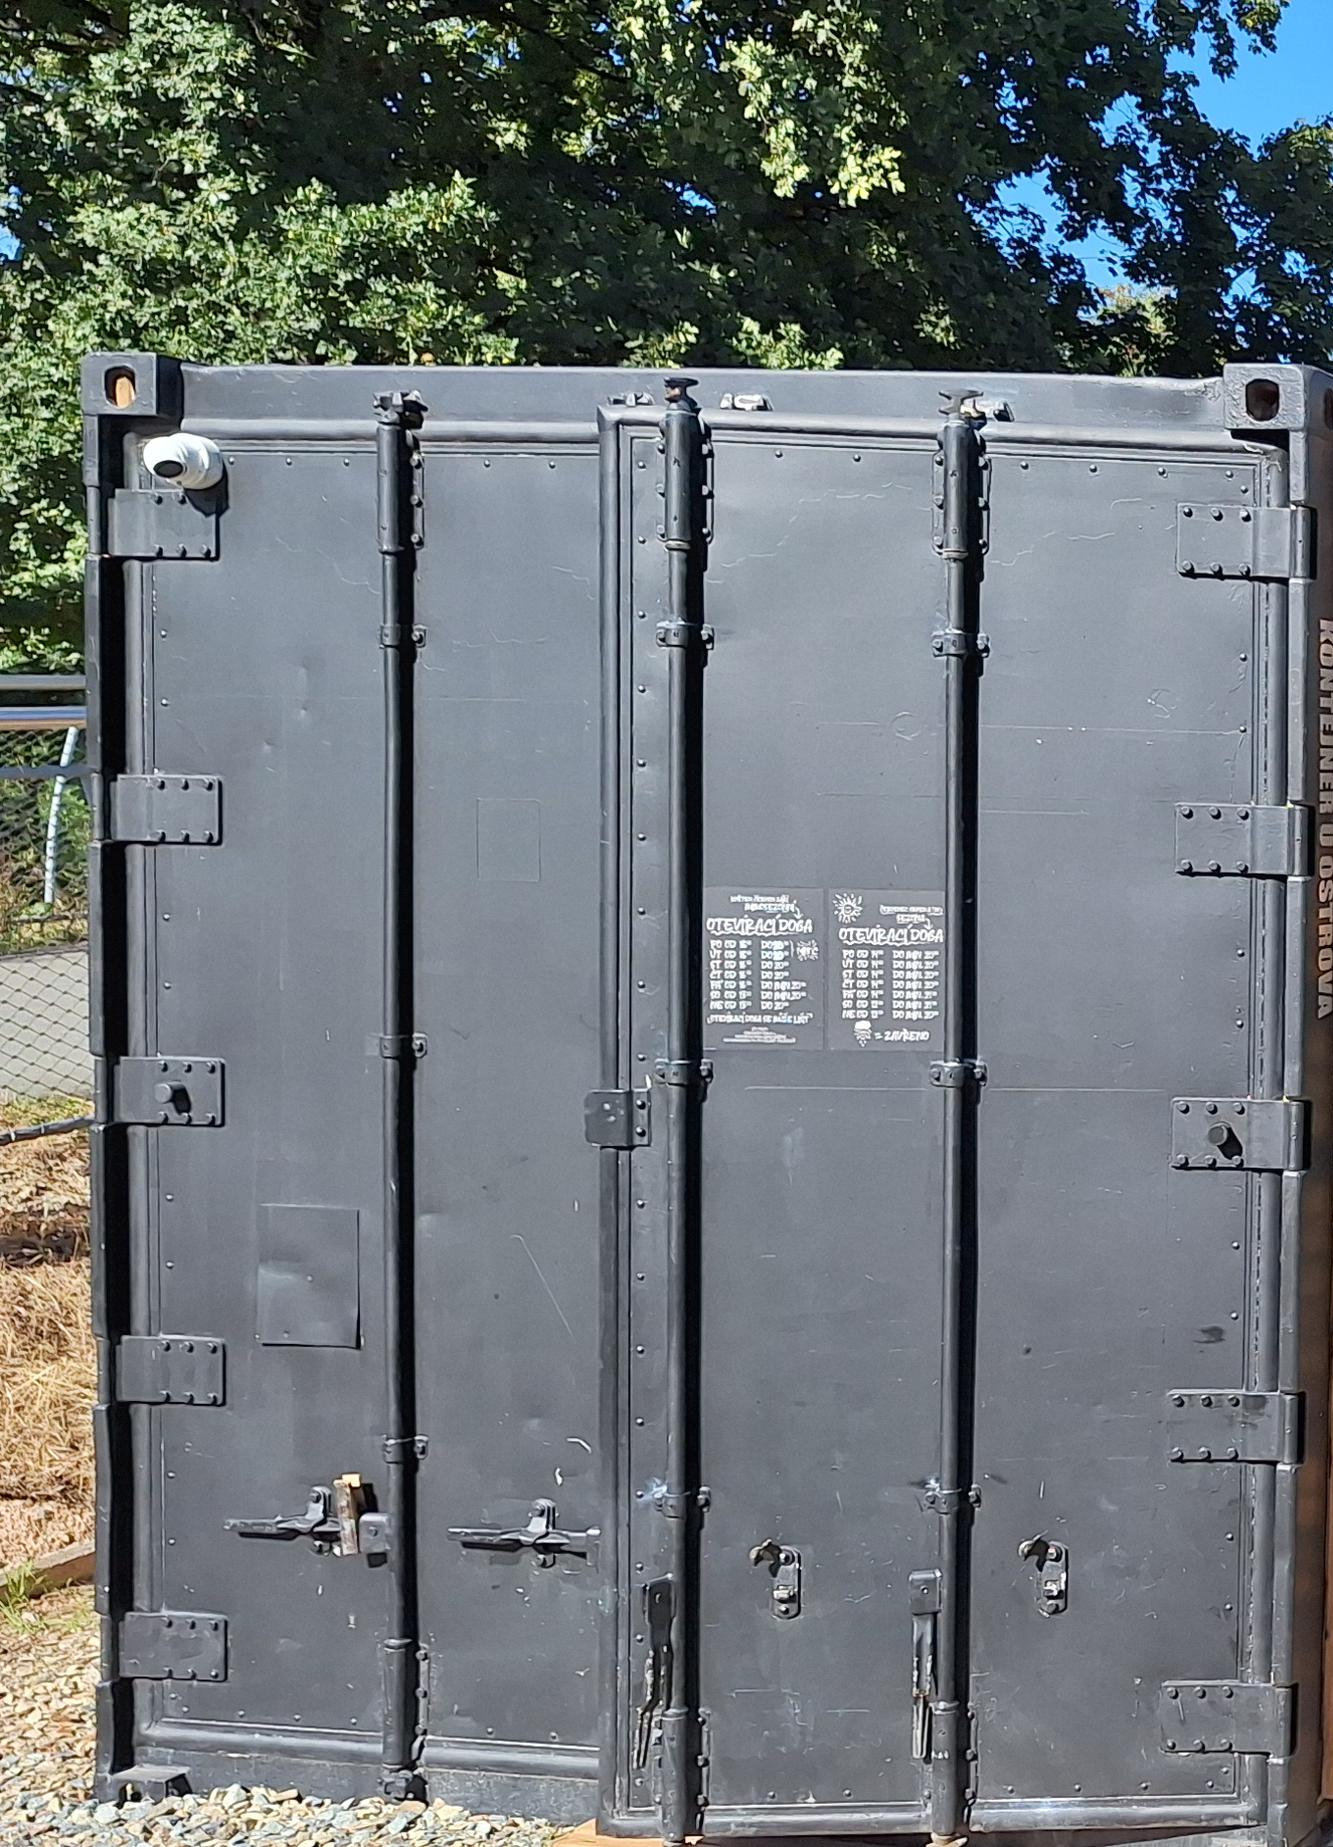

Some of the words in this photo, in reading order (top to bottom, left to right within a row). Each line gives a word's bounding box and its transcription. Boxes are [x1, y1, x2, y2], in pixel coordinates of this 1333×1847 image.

[779, 918, 813, 934] DOBA
[910, 928, 944, 943] DOBA
[760, 940, 773, 949] DO
[760, 950, 773, 959] DO
[892, 949, 905, 958] DO
[760, 961, 773, 969] DO
[892, 960, 905, 968] DO
[760, 971, 773, 979] DO
[892, 970, 905, 979] DO
[760, 981, 773, 990] DO
[892, 980, 905, 988] DO
[760, 991, 773, 999] DO
[892, 990, 905, 998] DO
[760, 1001, 773, 1010] DO
[892, 1000, 905, 1008] DO
[892, 1010, 905, 1019] DO
